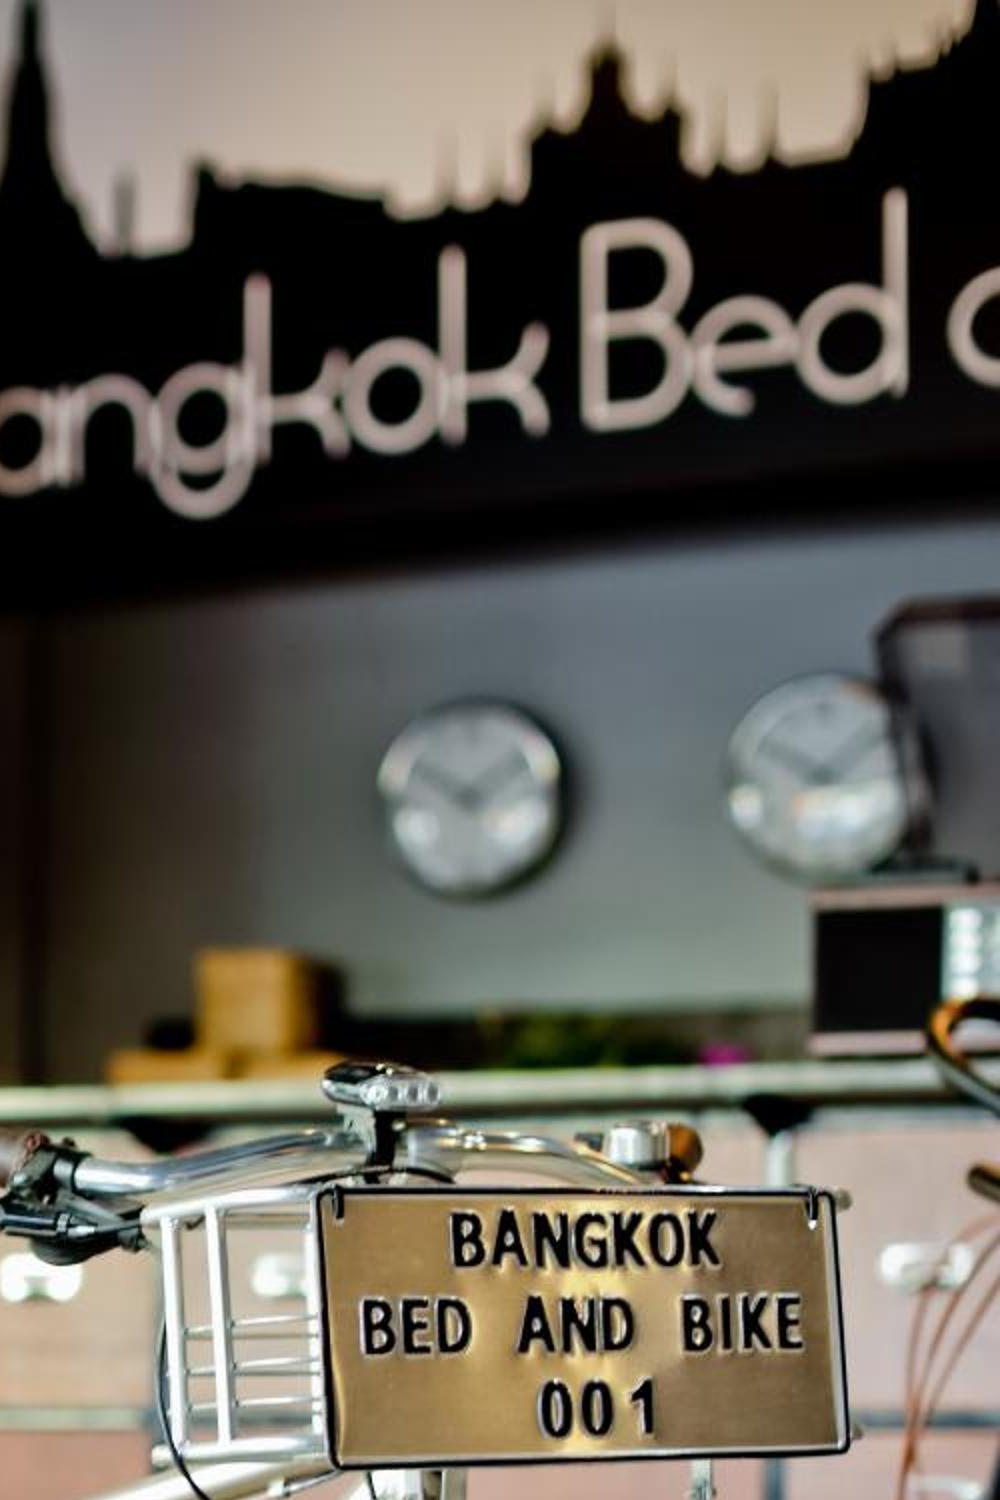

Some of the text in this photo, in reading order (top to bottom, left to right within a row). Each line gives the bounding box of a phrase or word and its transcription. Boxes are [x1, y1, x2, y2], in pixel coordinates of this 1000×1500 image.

[580, 187, 911, 431] Bed
[450, 1208, 722, 1269] BANGKOK
[361, 1293, 804, 1356] BED AND BIKE
[538, 1377, 657, 1440] 001
